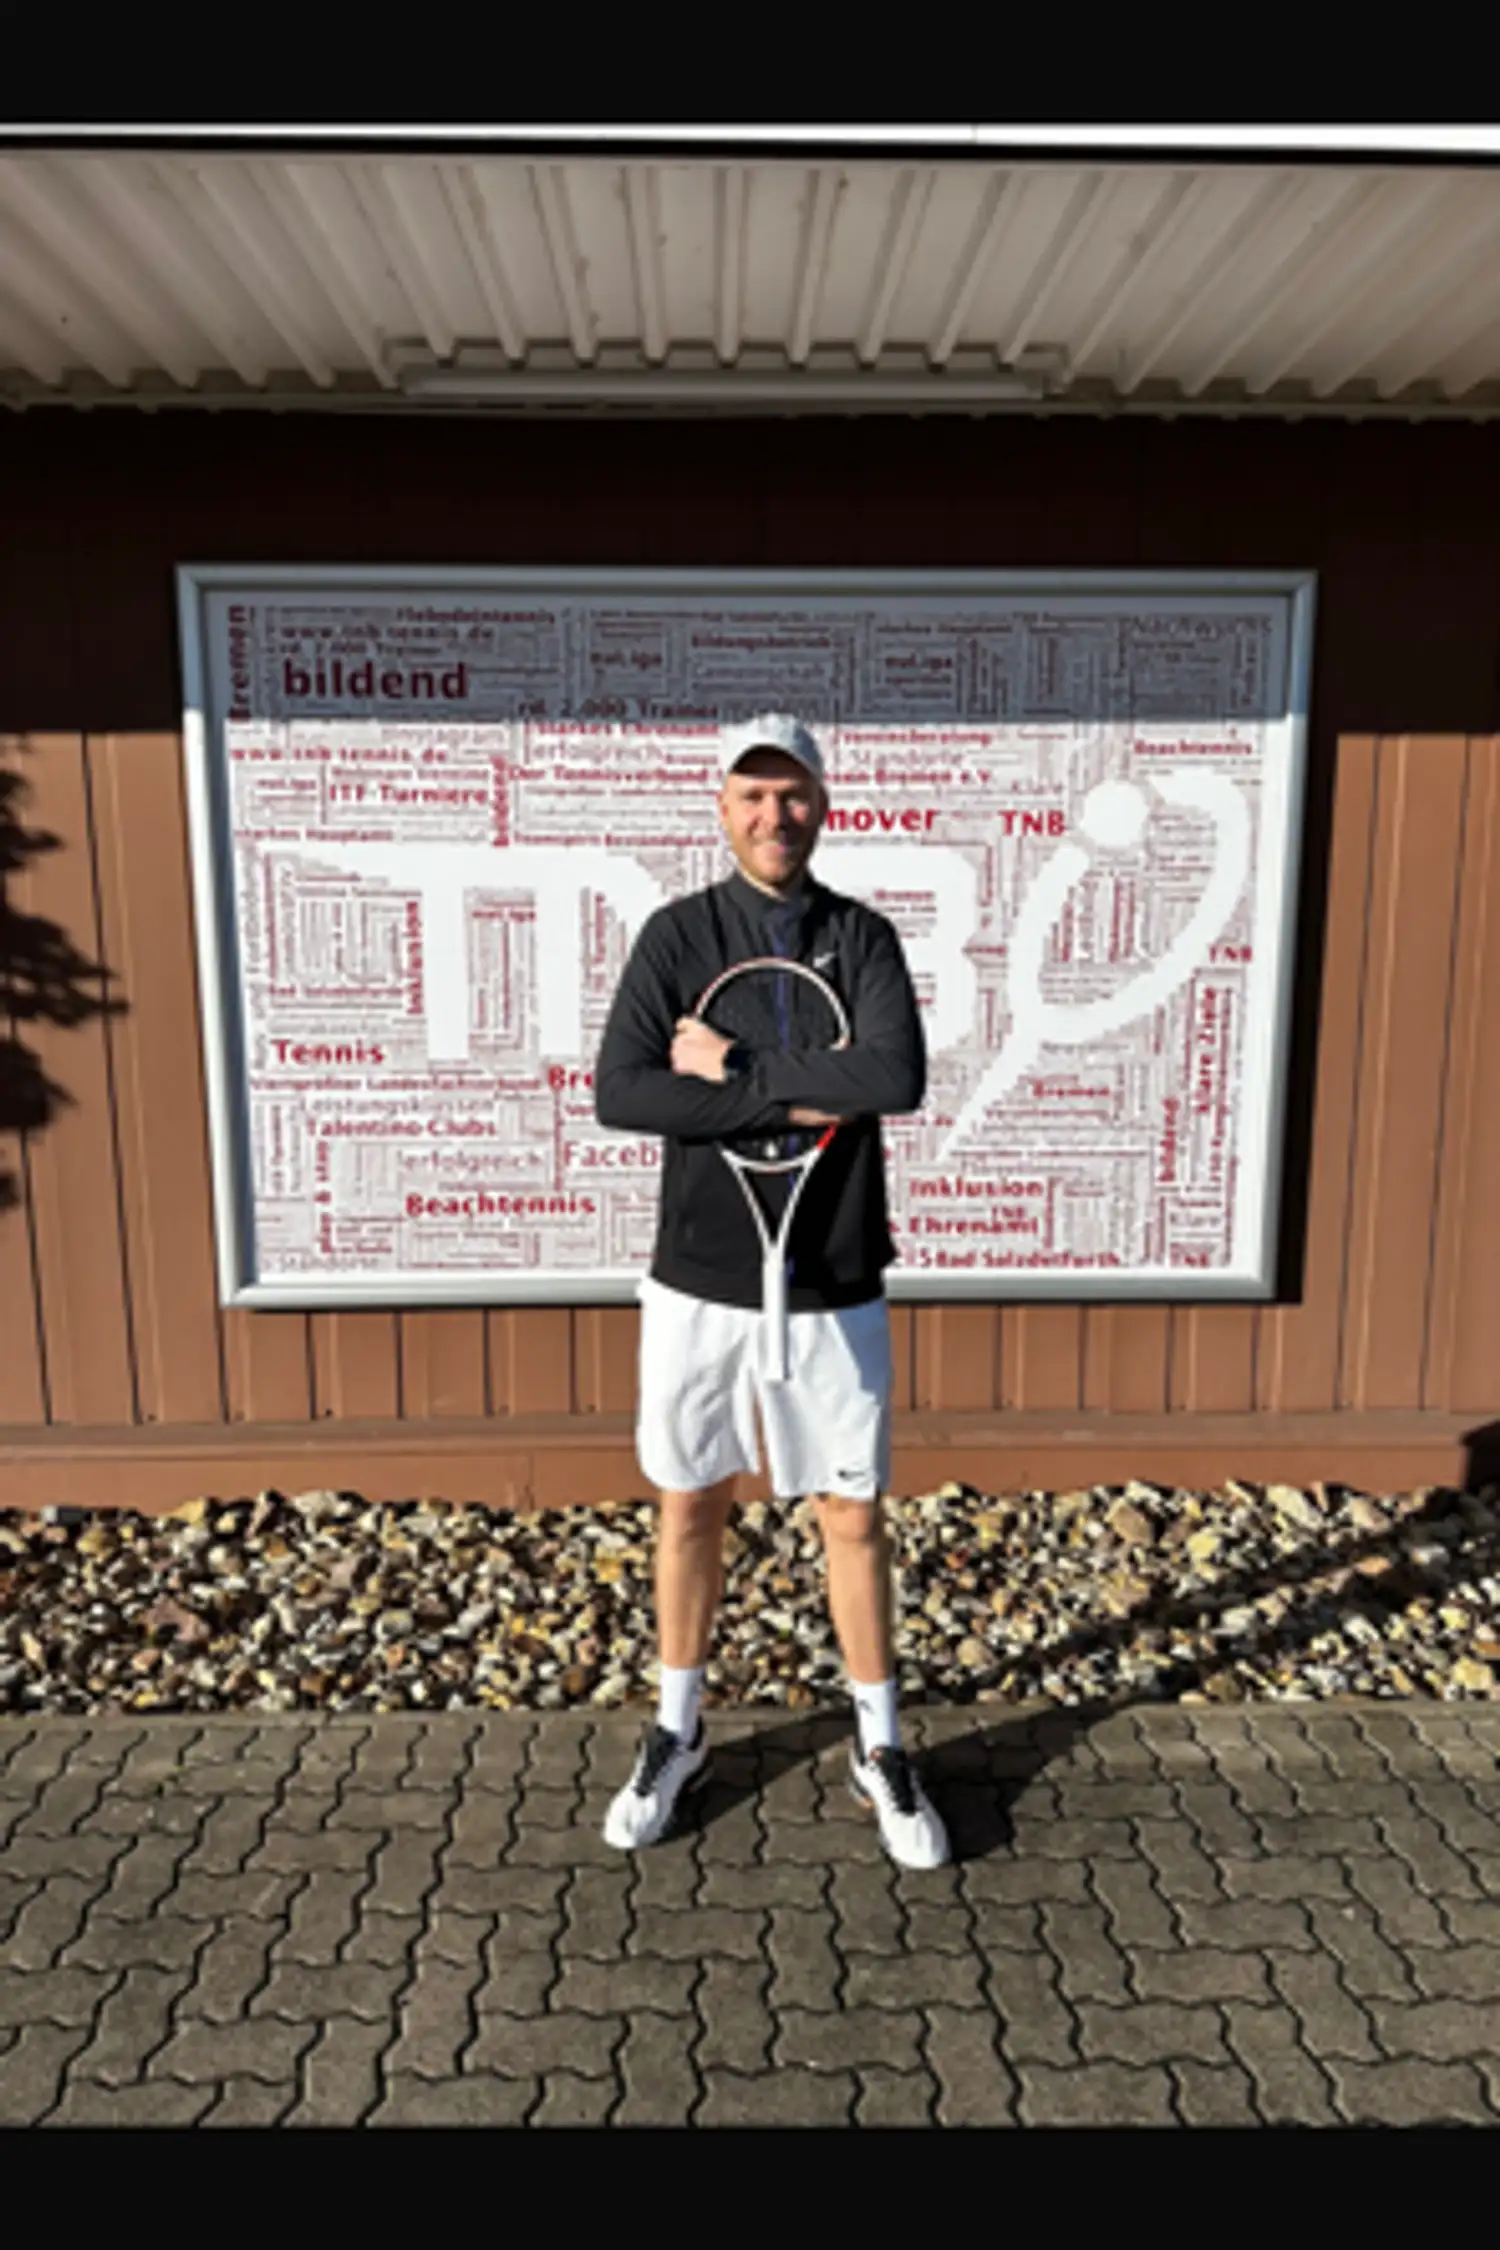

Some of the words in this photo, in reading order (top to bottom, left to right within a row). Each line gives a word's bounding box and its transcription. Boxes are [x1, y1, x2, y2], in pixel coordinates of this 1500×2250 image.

[284, 658, 468, 699] bildend
[825, 807, 940, 833] nover
[998, 808, 1068, 837] TNB
[271, 1038, 386, 1065] Tennis
[563, 1139, 660, 1168] Faceb
[909, 1176, 1044, 1198] Inklusion
[405, 1192, 597, 1217] Beachtennis
[909, 1216, 1039, 1234] Ehrenamt
